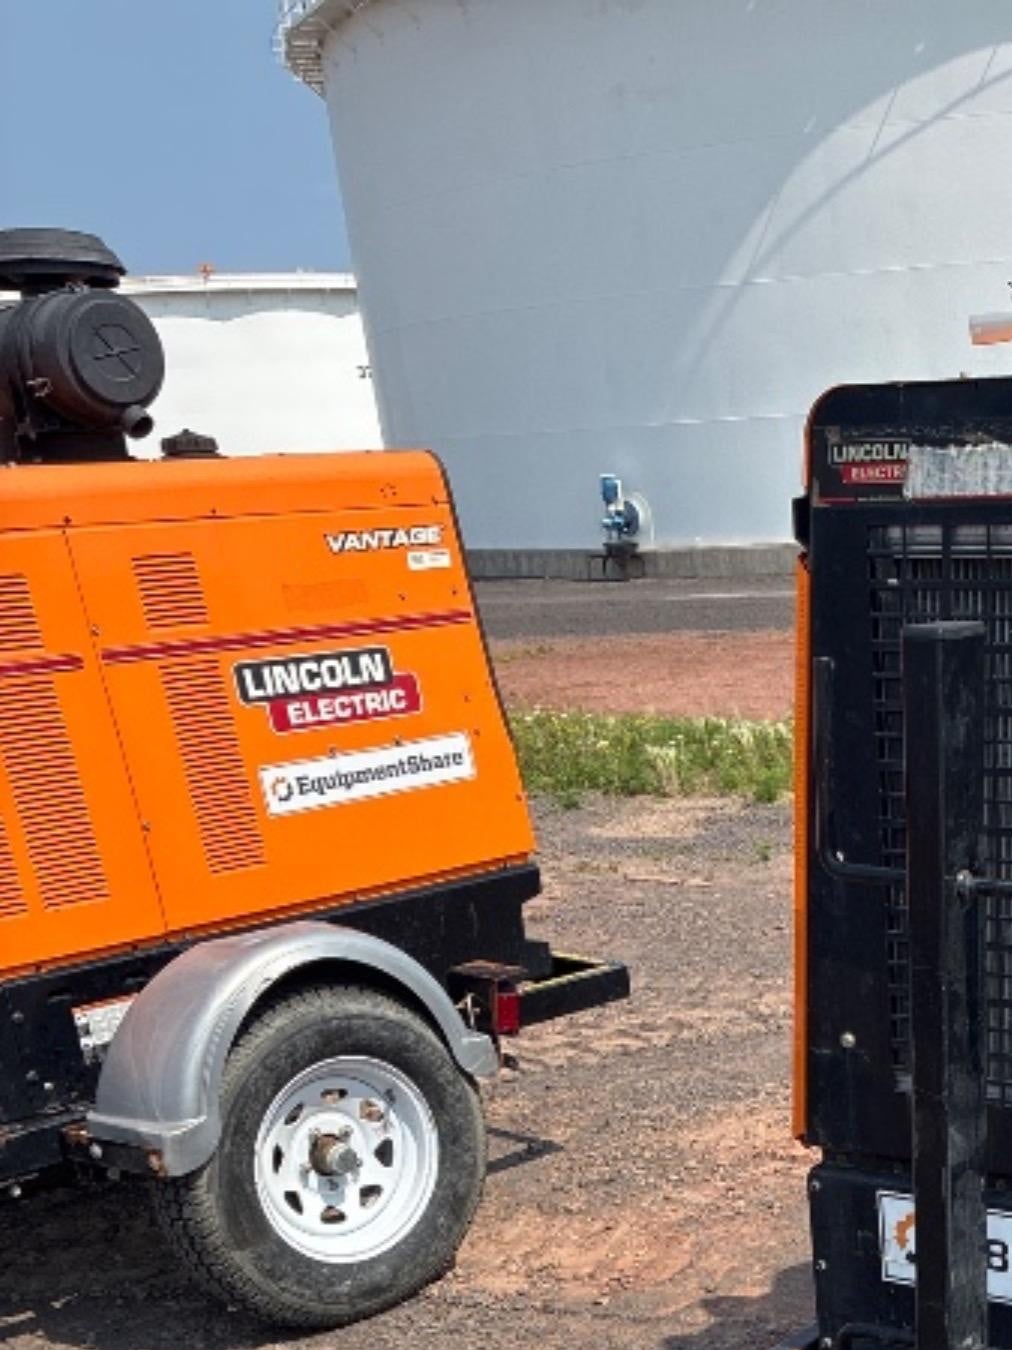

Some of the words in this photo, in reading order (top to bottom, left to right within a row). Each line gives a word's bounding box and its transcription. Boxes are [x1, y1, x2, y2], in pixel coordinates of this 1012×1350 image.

[832, 442, 909, 463] LINCOLN
[850, 465, 907, 481] ELECTR
[324, 525, 443, 554] VANTAGE
[241, 652, 386, 699] LINCOLN
[286, 688, 408, 726] ELECTRIC
[295, 750, 465, 797] EquipmentShare
